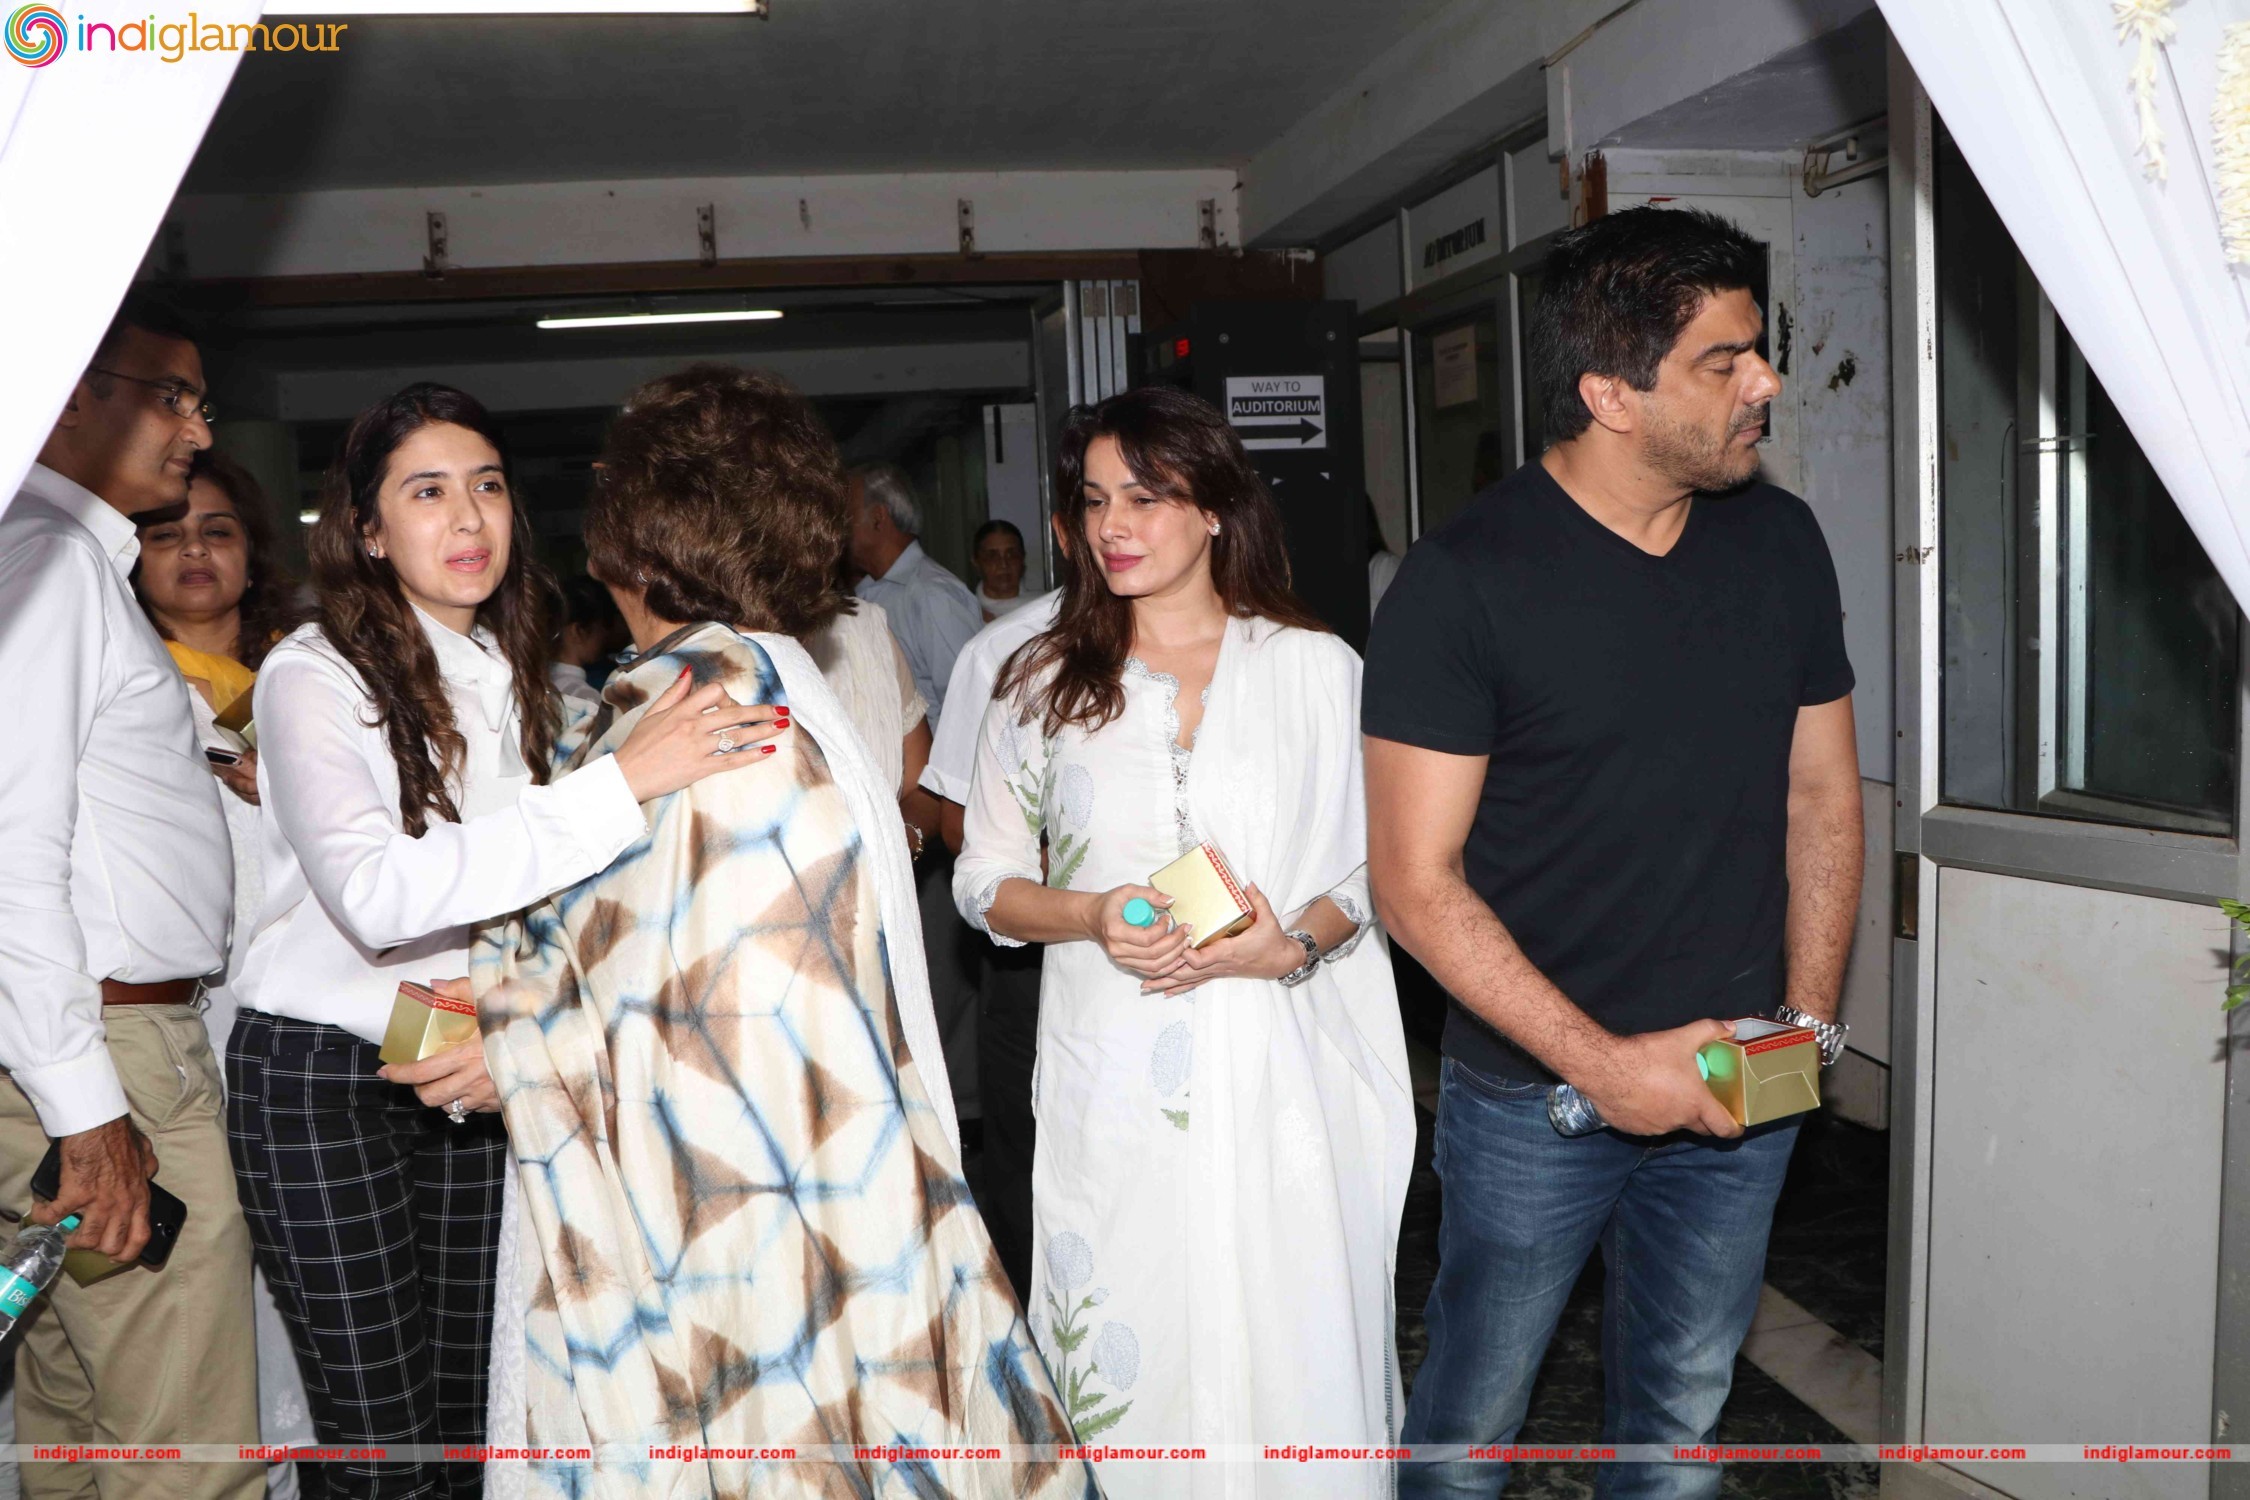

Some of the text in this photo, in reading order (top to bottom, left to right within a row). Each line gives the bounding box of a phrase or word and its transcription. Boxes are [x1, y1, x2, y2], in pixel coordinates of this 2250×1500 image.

[1251, 380, 1301, 393] WAY TO
[1232, 400, 1320, 414] AUDITORIUM
